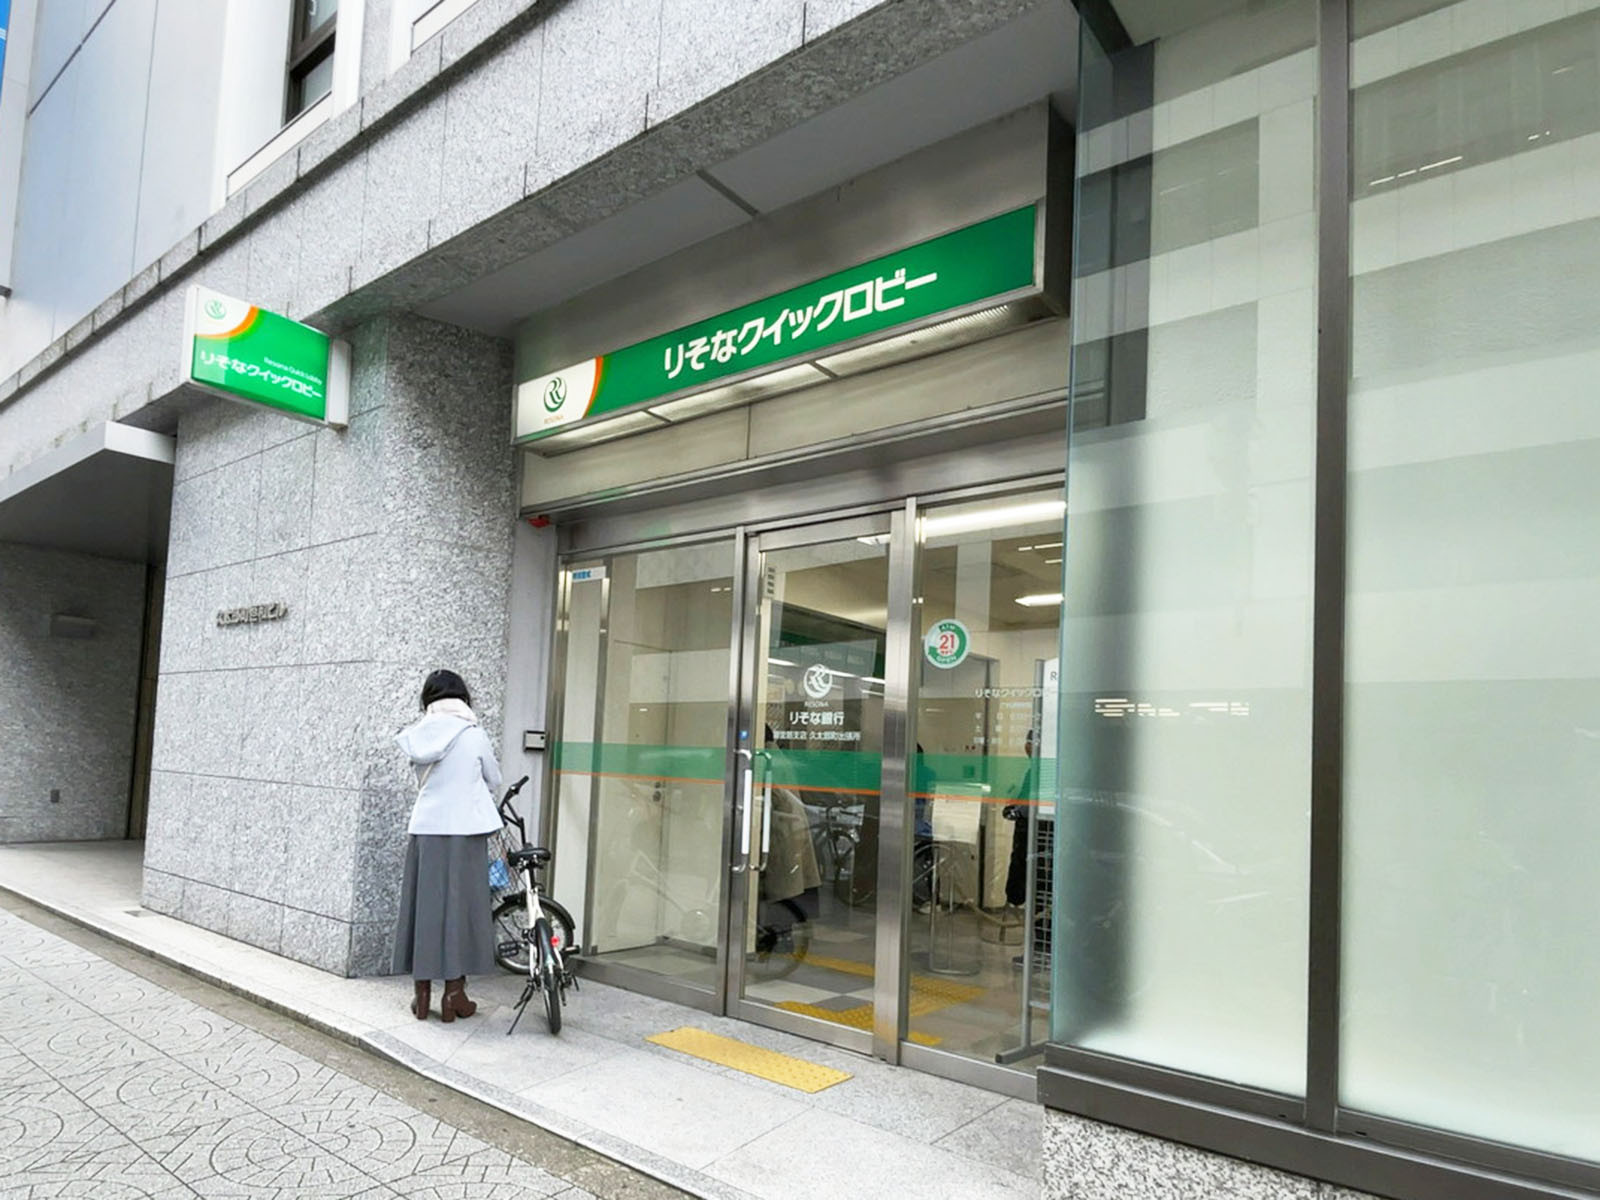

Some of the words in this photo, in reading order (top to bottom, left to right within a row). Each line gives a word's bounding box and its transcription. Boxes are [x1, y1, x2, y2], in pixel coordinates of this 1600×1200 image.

[664, 268, 938, 379] りそなクイックロビー
[200, 350, 323, 398] りそなクイックロビー
[939, 634, 954, 650] 21
[789, 711, 844, 725] りそな銀行
